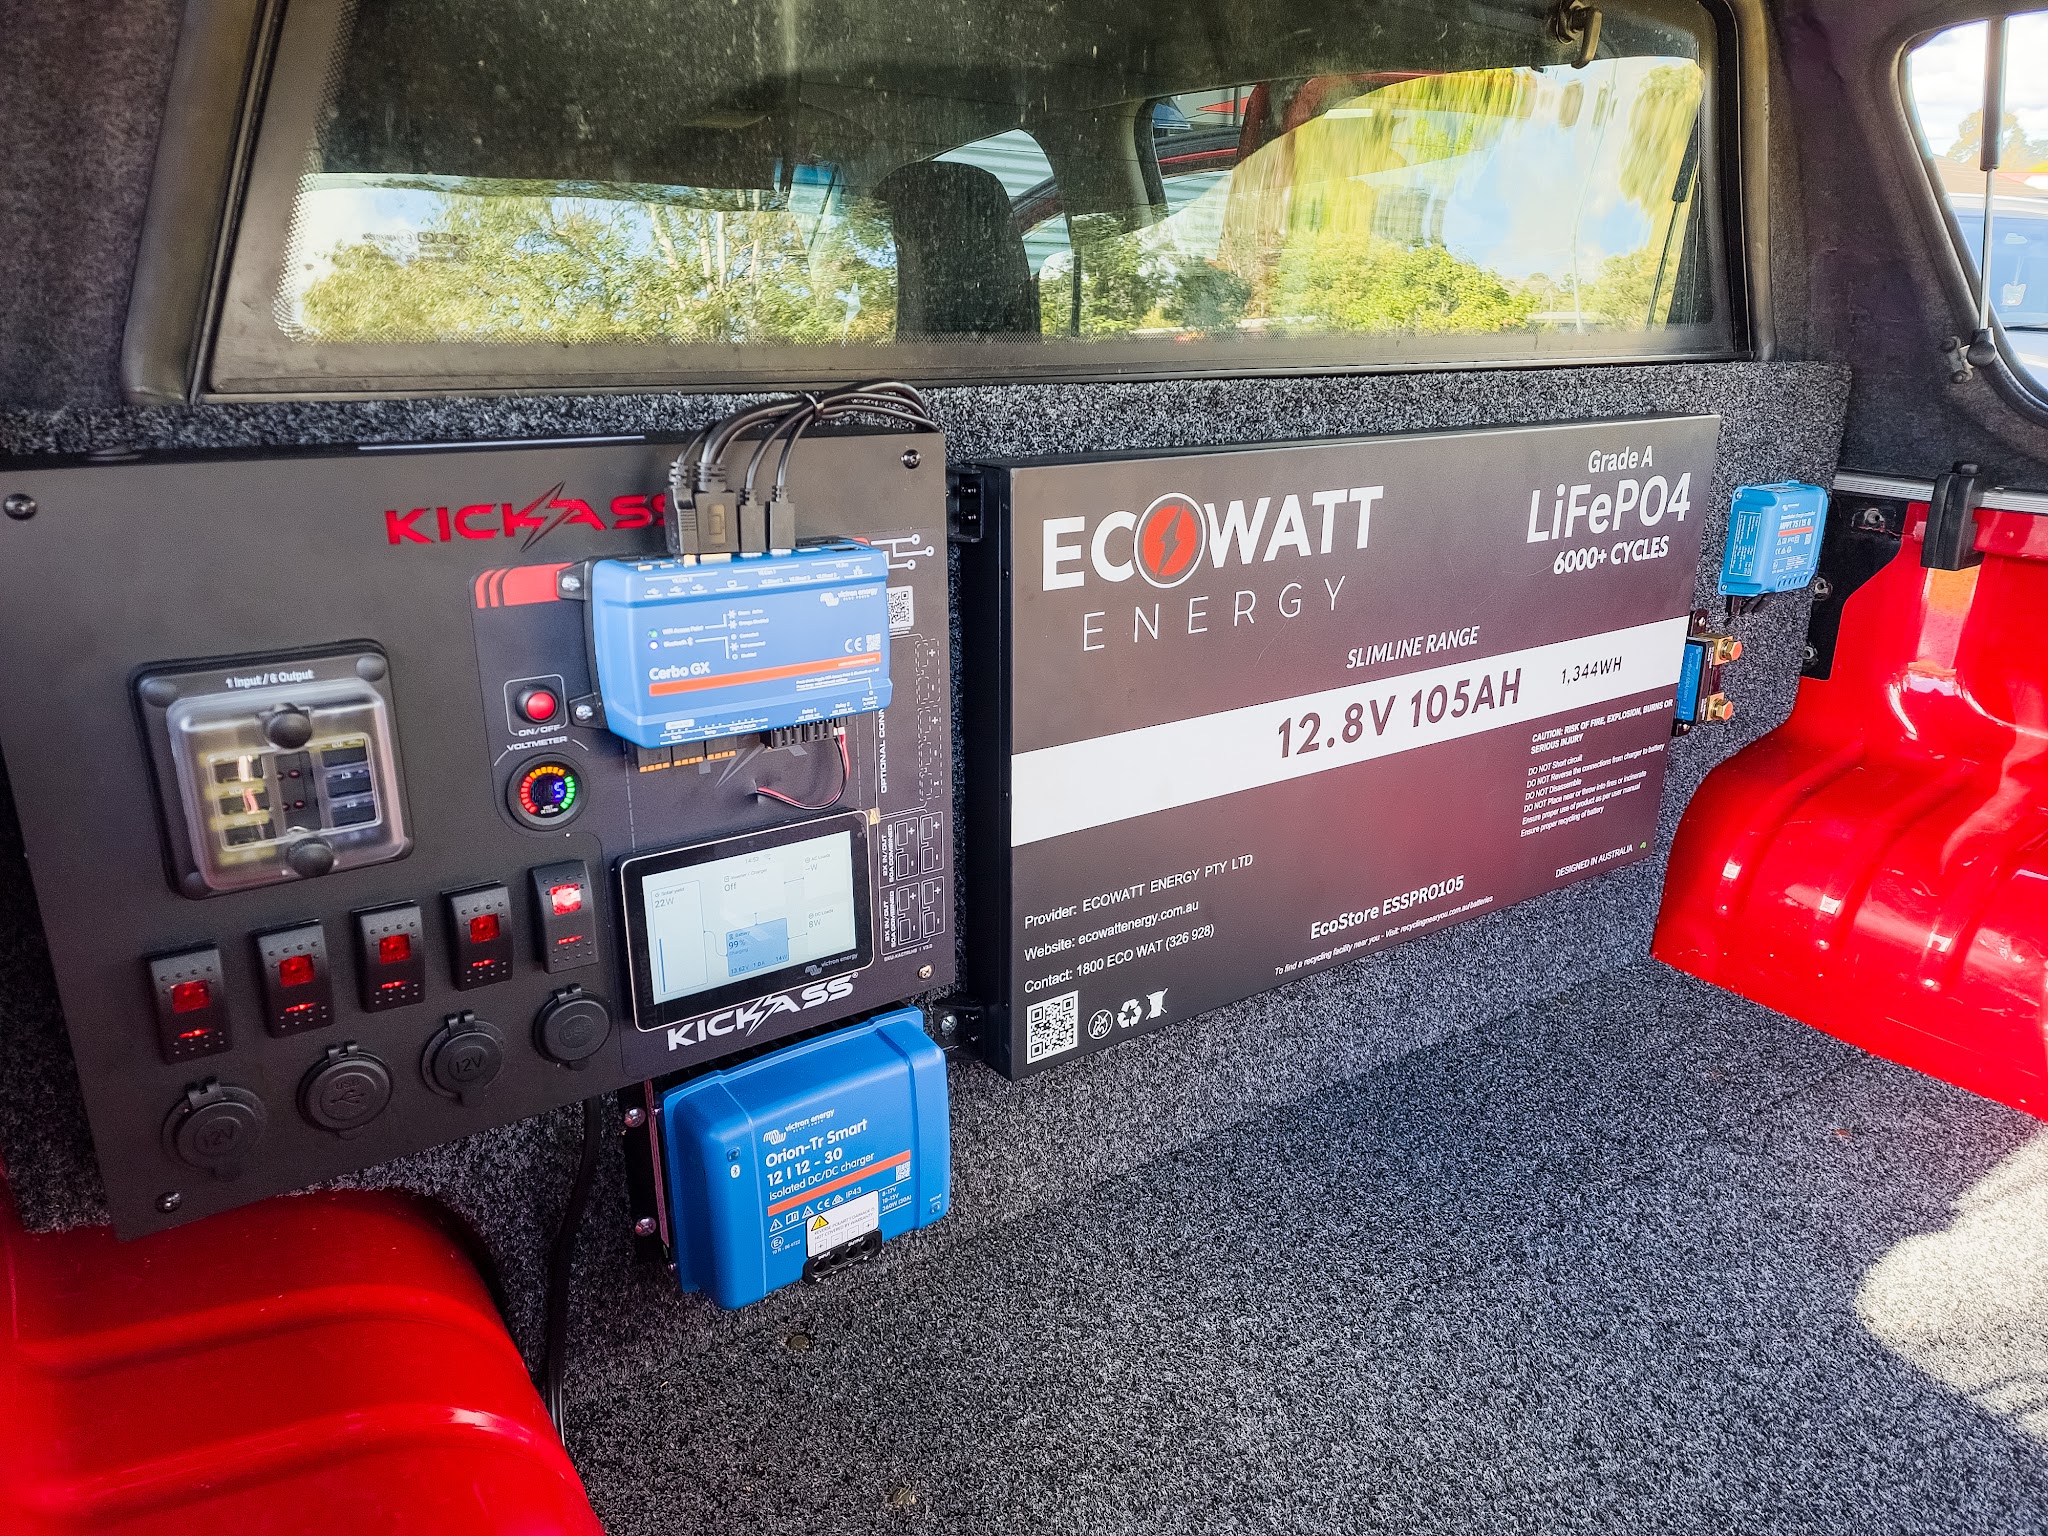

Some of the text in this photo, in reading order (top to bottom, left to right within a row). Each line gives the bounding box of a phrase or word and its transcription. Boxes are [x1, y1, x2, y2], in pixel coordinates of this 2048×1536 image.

[1588, 445, 1653, 474] Grade A
[1526, 472, 1692, 544] LiFePO4
[1042, 486, 1384, 591] ECOWATT
[1553, 535, 1670, 575] 6000+ CYCLES
[1083, 576, 1346, 651] ENERGY
[1345, 626, 1480, 669] SLIMLINE RANGE
[234, 676, 262, 689] Input
[278, 669, 315, 684] Output
[649, 661, 711, 680] Cerbo GX
[1560, 656, 1623, 686] 1,344WH
[518, 724, 561, 737] ON/OFF
[1278, 668, 1522, 758] 12.8V 105AH
[1532, 699, 1673, 742] CAUTION: RISK OF FIRE, EXPLOSION, BURNS OR
[507, 736, 568, 751] VOLTMETER
[1530, 733, 1584, 754] SERIOUS INJURY
[879, 739, 888, 793] OPTIONAL
[1526, 779, 1536, 788] DO
[1537, 775, 1550, 785] NOT
[1551, 769, 1573, 781] Reverse
[1573, 766, 1581, 775] the
[1582, 758, 1612, 773] connections
[1612, 755, 1623, 764] from
[1624, 749, 1642, 760] charger
[1648, 743, 1665, 753] battery
[1528, 754, 1583, 776] DO NOT Short circuit
[1522, 814, 1541, 825] Ensure
[1541, 808, 1559, 820] proper
[1569, 802, 1576, 810] of
[1576, 797, 1595, 810] product
[1602, 792, 1611, 802] per
[1611, 789, 1623, 797] user
[1622, 782, 1641, 794] manual
[1523, 803, 1533, 813] DO
[1534, 799, 1547, 810] NOT
[1547, 796, 1562, 806] Place
[1563, 792, 1575, 801] near
[1582, 786, 1596, 795] throw
[1596, 783, 1606, 791] into
[1606, 780, 1617, 788] fires
[1617, 777, 1623, 785] or
[1624, 770, 1647, 782] incinerate
[1525, 778, 1582, 800] DO NOT Disassemble
[1520, 806, 1604, 837] Ensure proper recycling of battery
[1555, 844, 1633, 878] DESIGNED IN AUSTRALIA
[654, 897, 675, 909] 22W
[724, 882, 737, 892] Off
[1024, 853, 1254, 929] Provider: ECOWATT ENERGY PTY LTD
[808, 918, 822, 929] 8W
[1310, 875, 1465, 940] EcoStore ESSPRO105
[728, 940, 739, 950] 99
[1024, 901, 1199, 962] Website: ecowattenergy.com.au
[1275, 966, 1283, 976] To
[1284, 961, 1297, 973] find
[1303, 950, 1332, 967] recycling
[1333, 943, 1353, 956] facility
[1353, 938, 1368, 949] near
[1367, 934, 1381, 946] you
[1385, 927, 1400, 938] Visit:
[1400, 895, 1494, 932] recyclingnearyou.com.au/batteries
[821, 953, 859, 968] victron energy
[1024, 923, 1215, 994] Contact: 1800 ECO WAT (326 928)
[667, 975, 854, 1051] KICKASS
[455, 1054, 483, 1074] 12V
[785, 1119, 809, 1132] victron
[810, 1109, 835, 1123] energy
[765, 1135, 824, 1168] Orion-Tr
[827, 1119, 868, 1145] Smart
[767, 1170, 784, 1187] 12
[795, 1159, 811, 1176] 12
[824, 1147, 843, 1164] 30
[769, 1153, 875, 1201] isolated DC/DC charger
[846, 1186, 862, 1199] IP43
